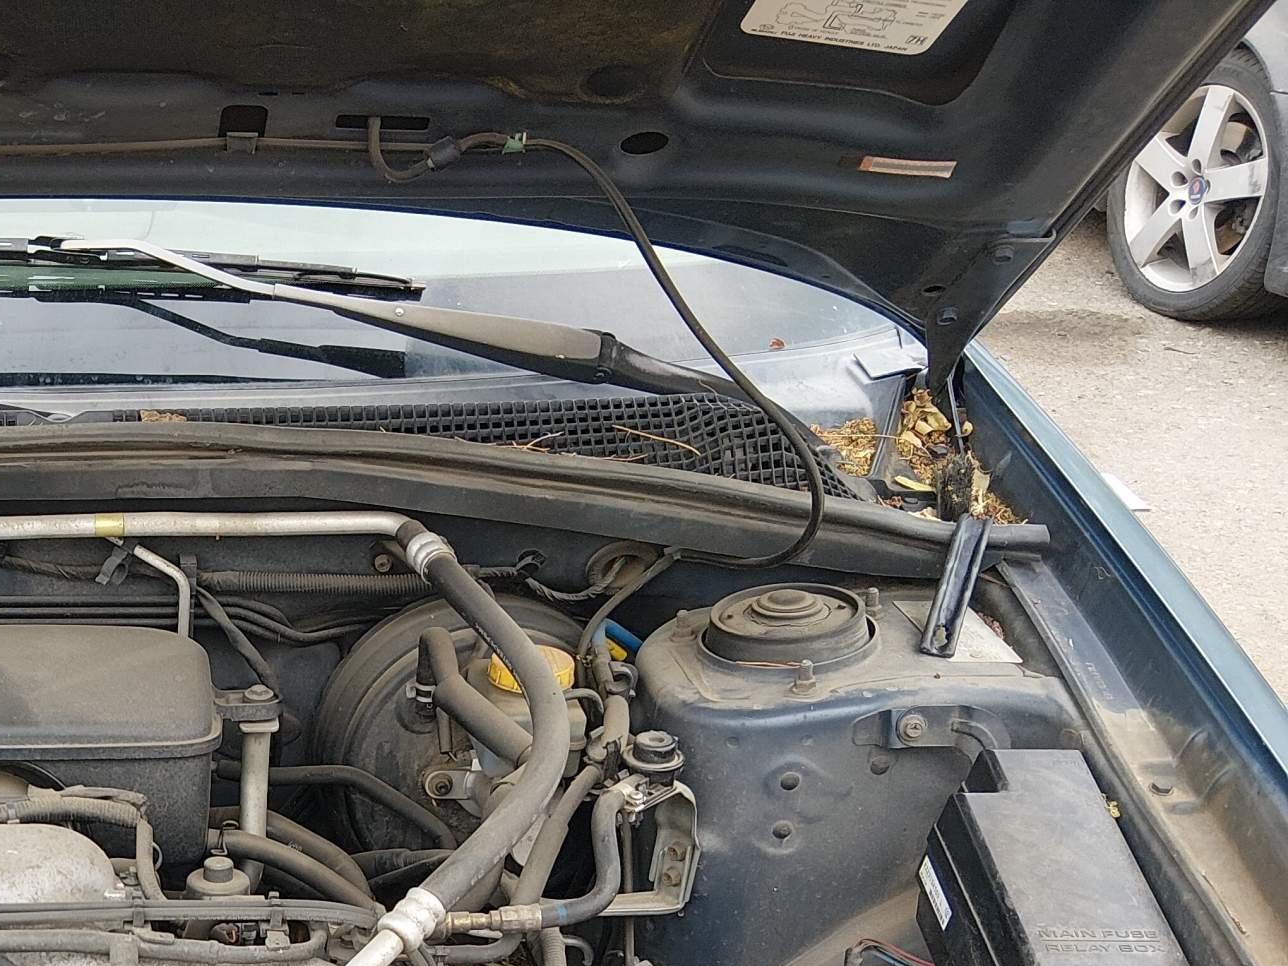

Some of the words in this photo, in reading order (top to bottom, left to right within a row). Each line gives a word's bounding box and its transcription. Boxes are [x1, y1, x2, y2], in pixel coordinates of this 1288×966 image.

[824, 36, 865, 46] INDUSTRIES
[1036, 929, 1097, 938] MAIN
[1102, 929, 1159, 939] FUSE
[1045, 944, 1111, 953] RELAY
[1118, 944, 1167, 953] BOX
